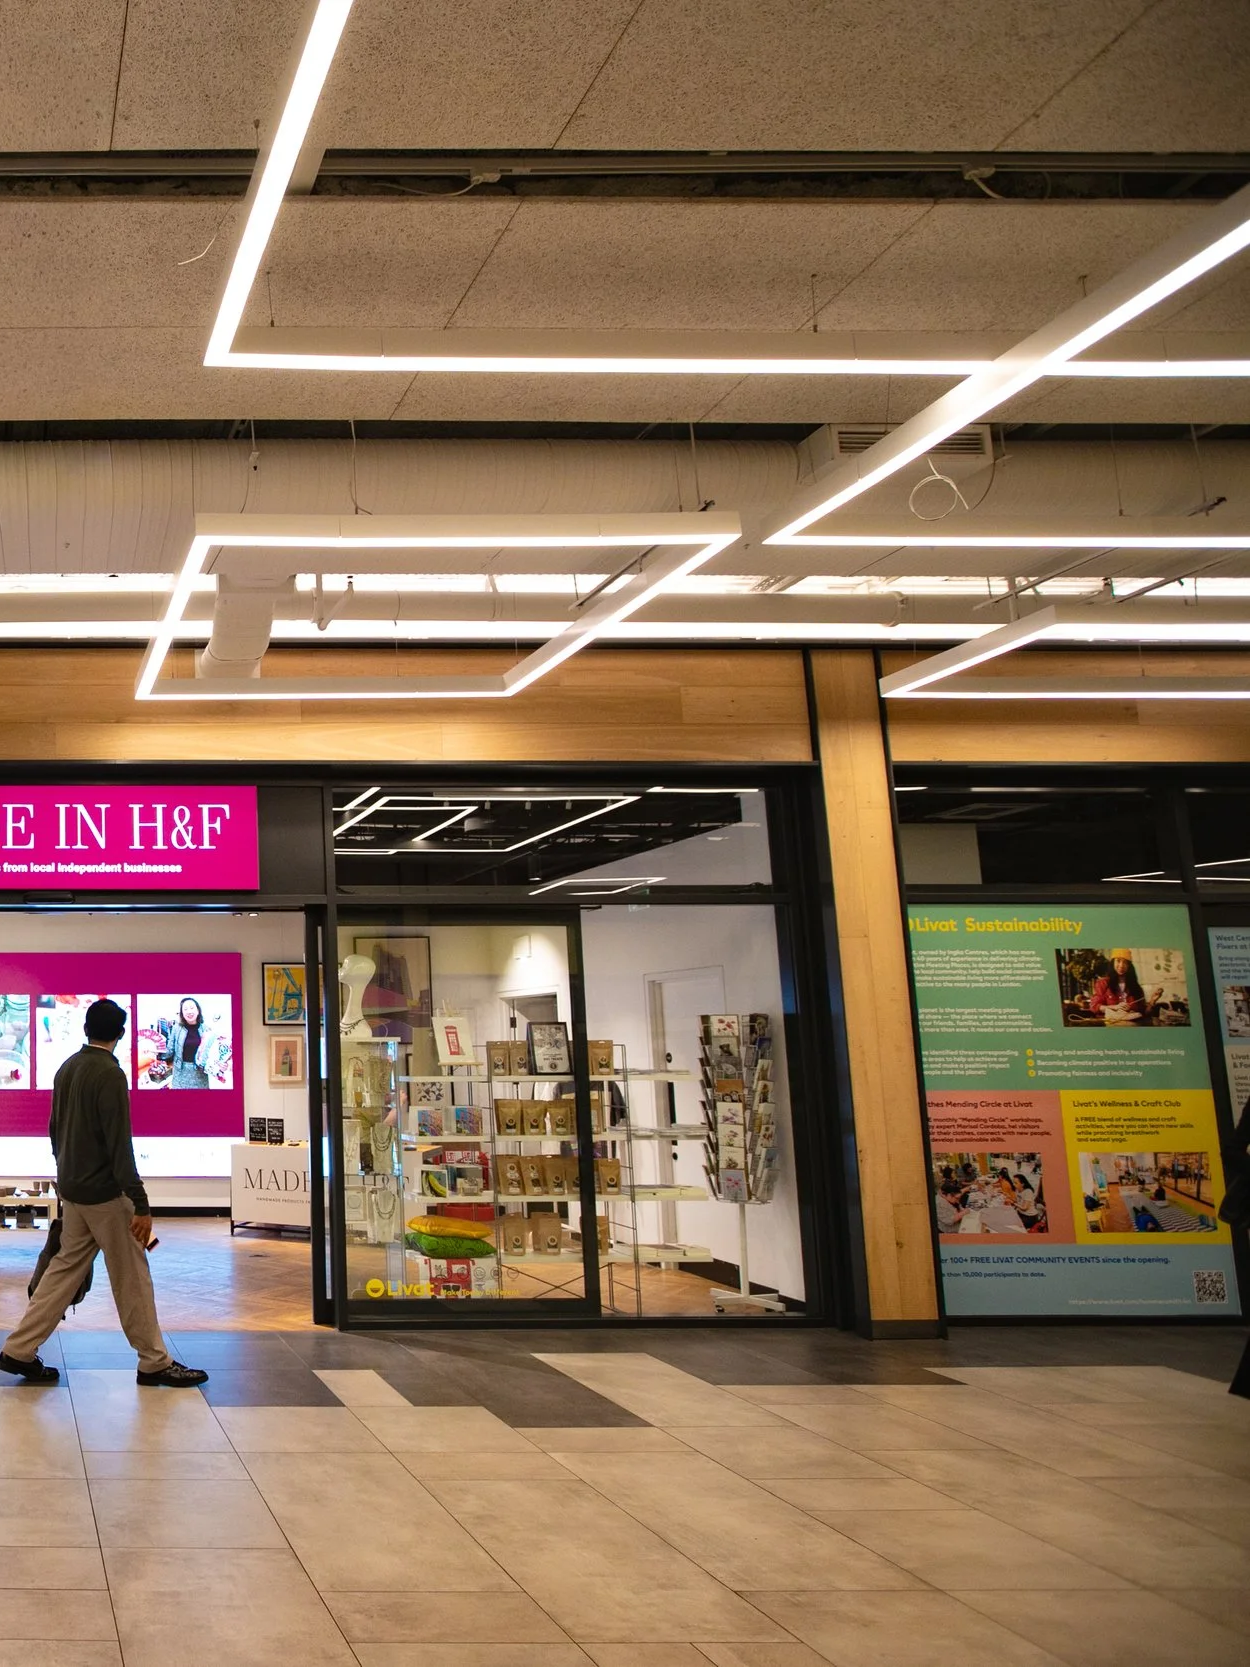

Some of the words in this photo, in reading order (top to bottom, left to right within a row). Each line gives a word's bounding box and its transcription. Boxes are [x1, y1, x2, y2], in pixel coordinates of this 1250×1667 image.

[54, 803, 111, 850] IN
[129, 803, 230, 850] H&F
[2, 862, 28, 872] from
[30, 862, 55, 872] local
[57, 862, 122, 874] independent
[124, 862, 182, 873] businesses
[916, 917, 958, 932] Livat
[965, 917, 1082, 935] Sustainability
[243, 1168, 310, 1192] MADE
[1138, 1257, 1170, 1266] opening.
[388, 1280, 435, 1297] Livat
